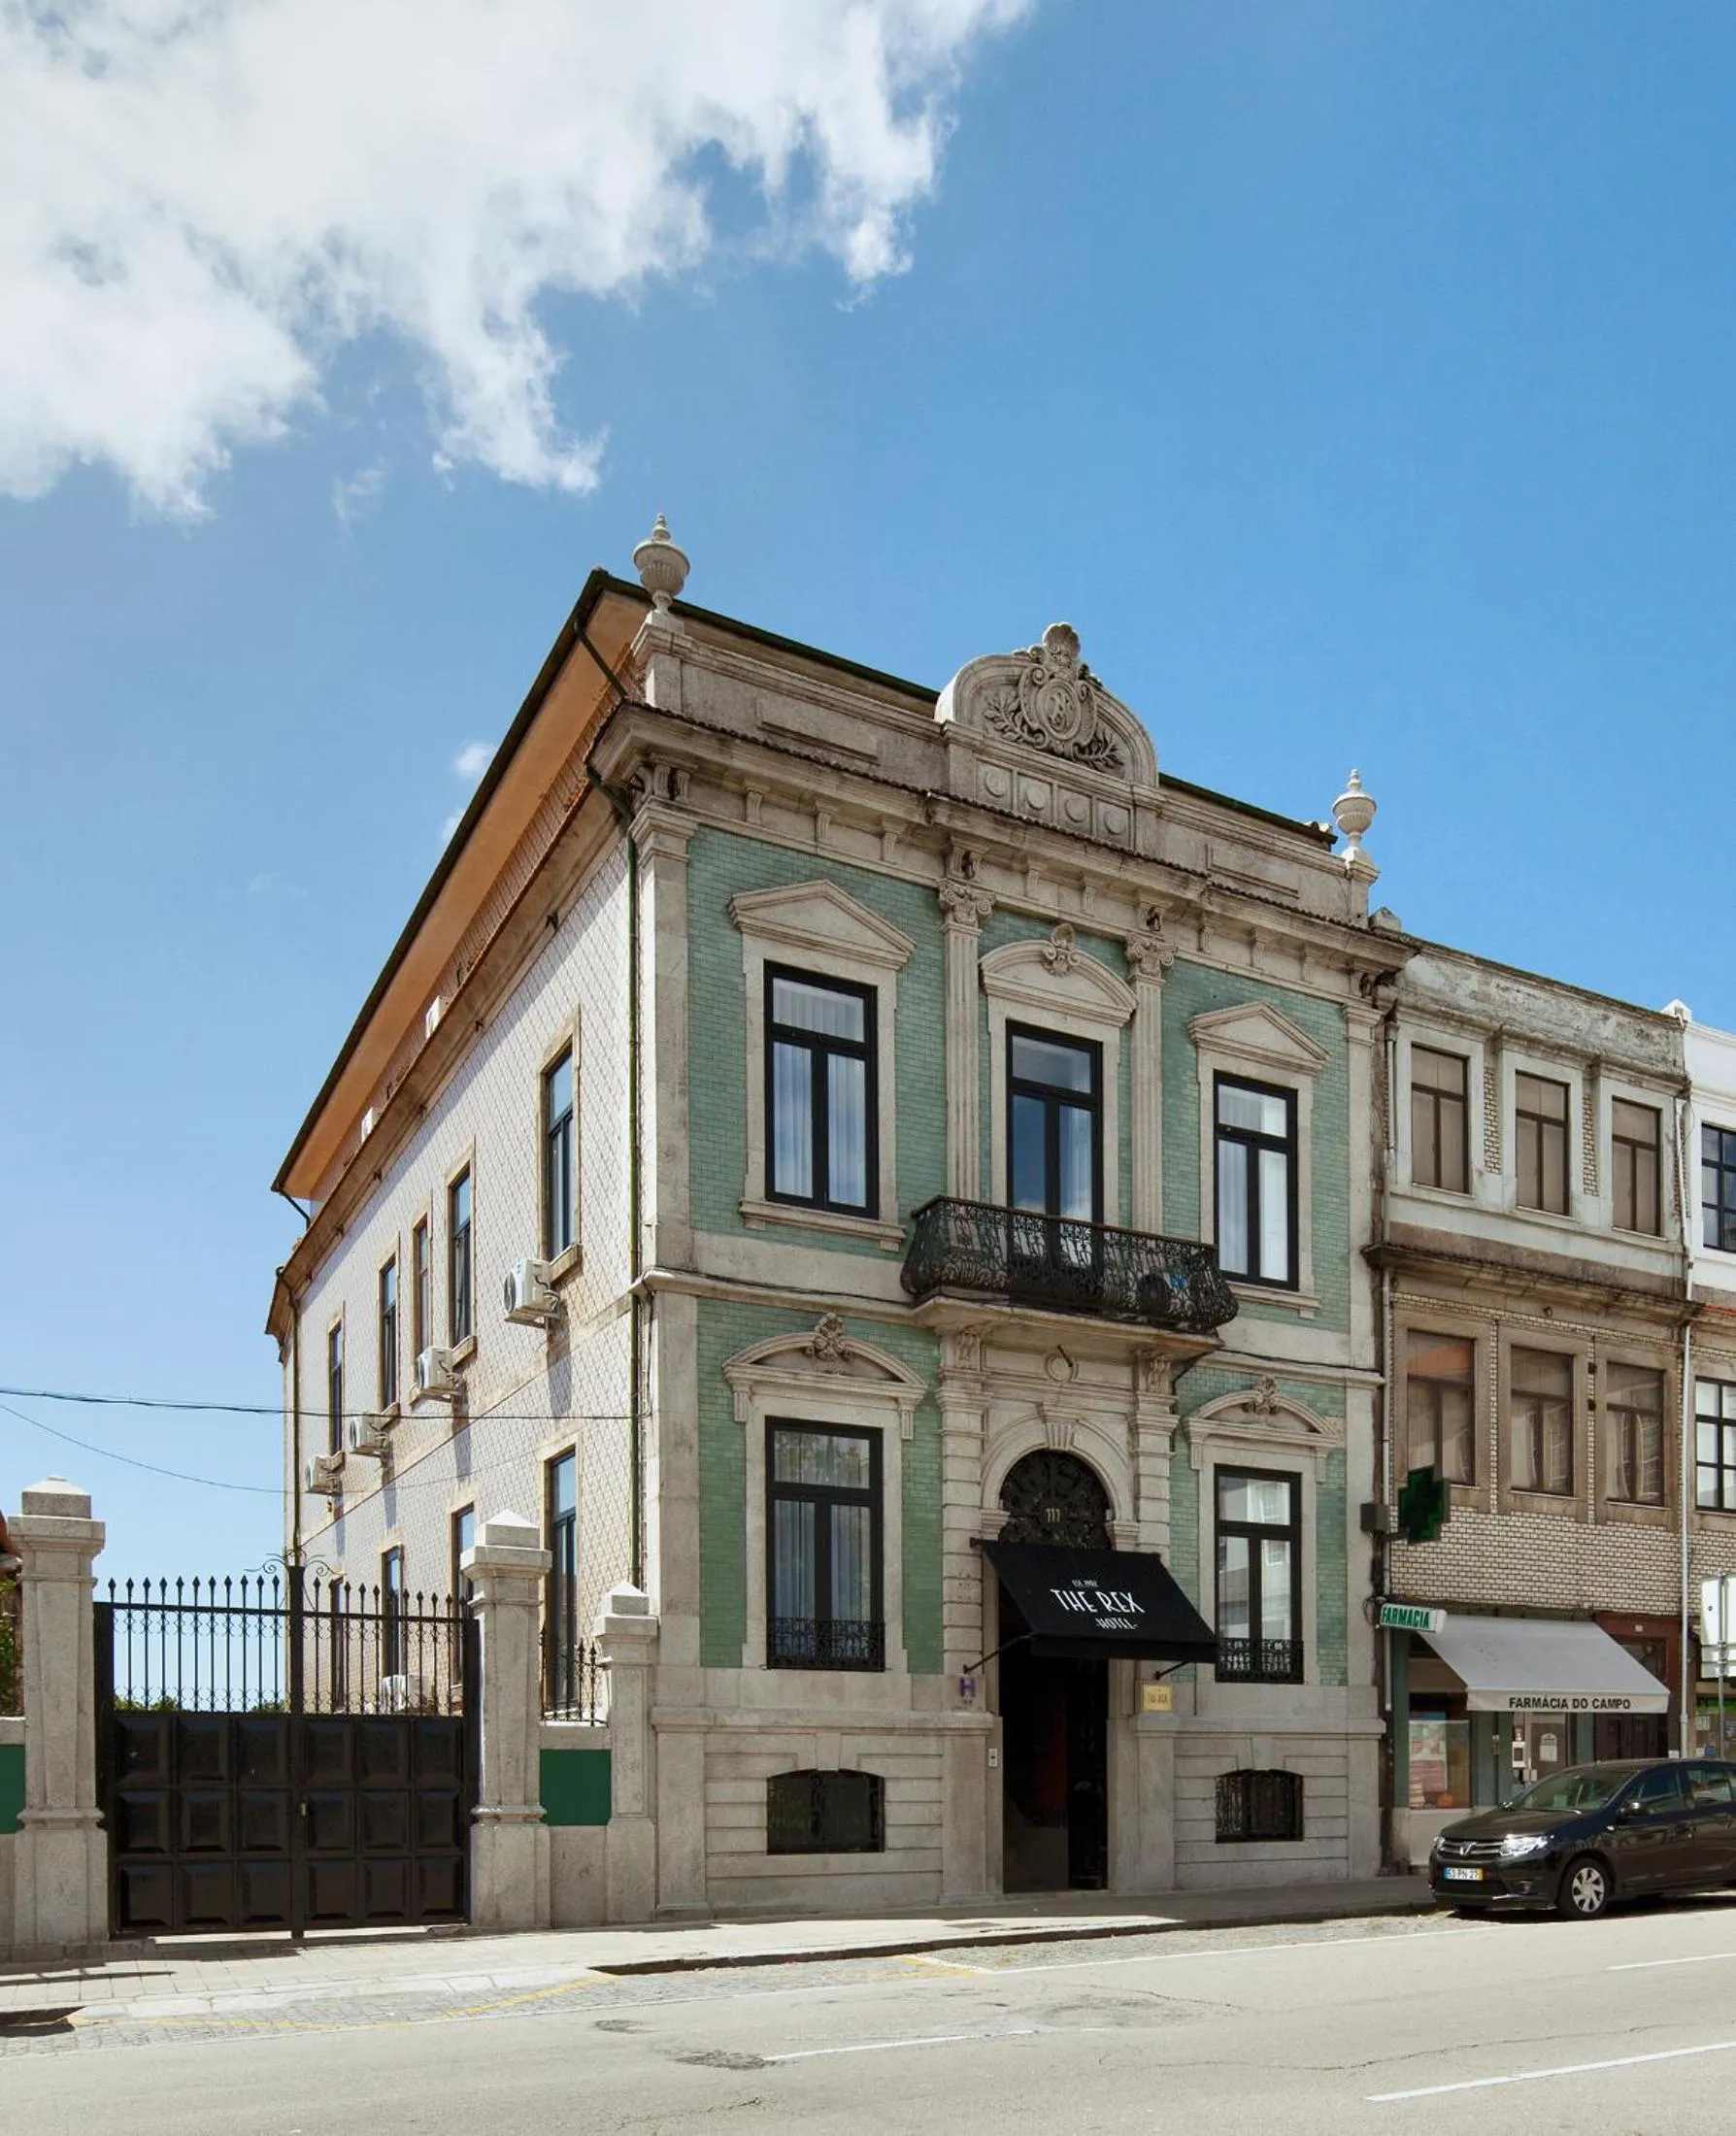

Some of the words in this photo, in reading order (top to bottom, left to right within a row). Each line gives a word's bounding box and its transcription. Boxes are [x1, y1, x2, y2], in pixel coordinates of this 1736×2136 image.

[1050, 1588, 1098, 1613] THE
[1095, 1591, 1146, 1613] REX
[1509, 1693, 1569, 1710] FARMÁCIA
[1572, 1697, 1588, 1710] DO
[1591, 1697, 1631, 1710] CAMPO
